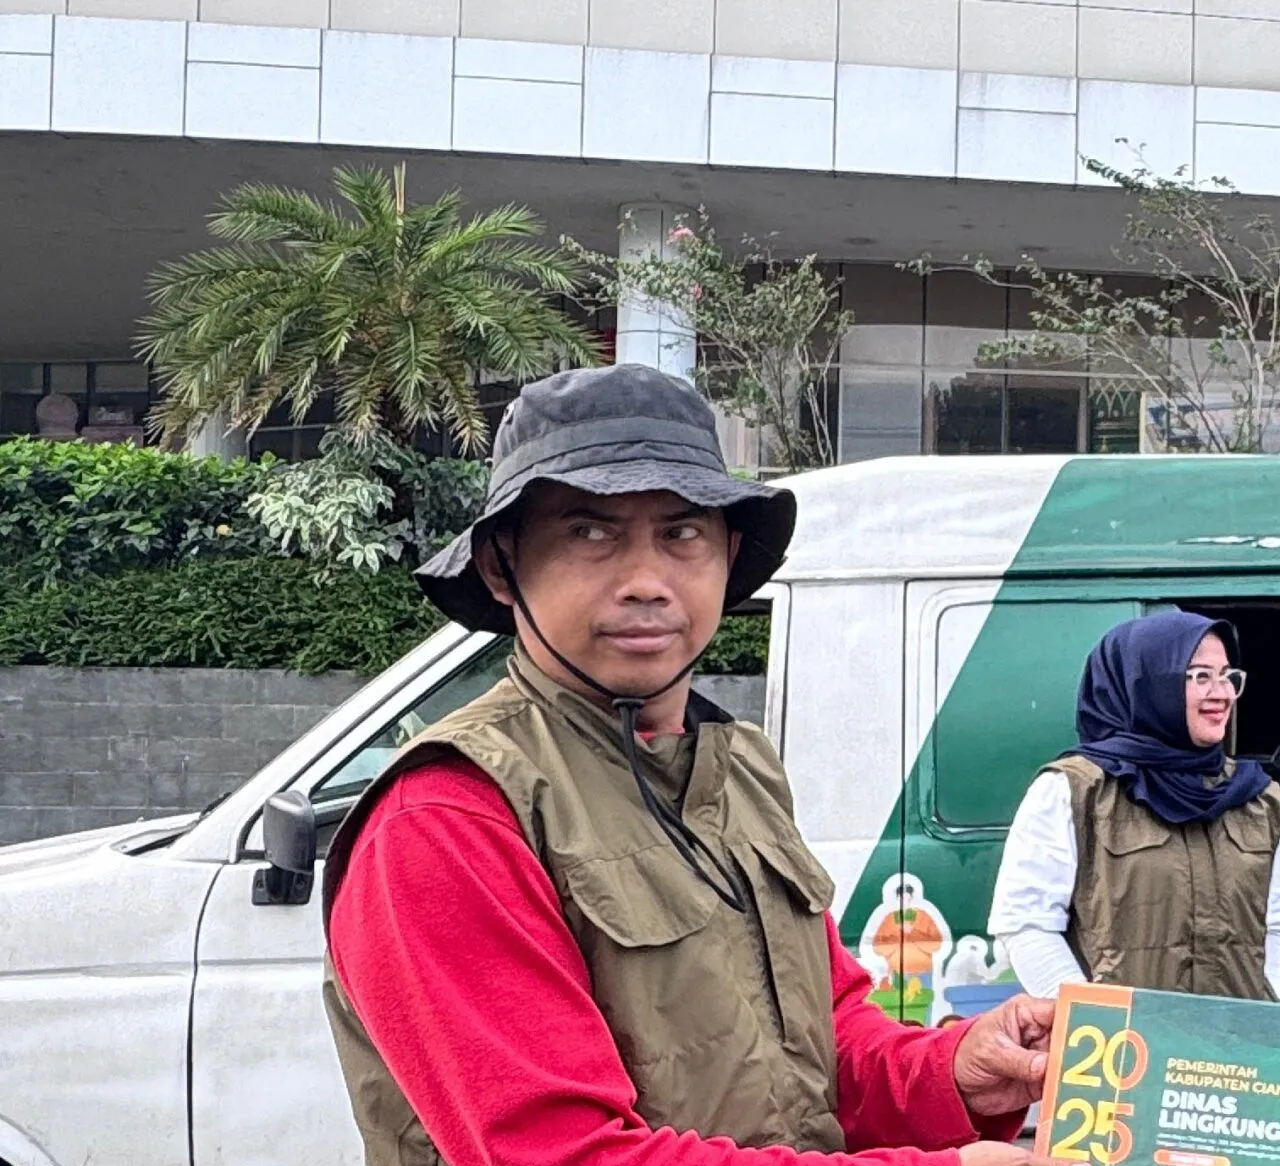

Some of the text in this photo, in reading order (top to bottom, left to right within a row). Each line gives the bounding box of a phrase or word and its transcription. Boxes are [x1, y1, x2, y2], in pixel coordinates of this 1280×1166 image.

[1062, 1025, 1148, 1090] 20
[1166, 1057, 1258, 1079] PEMERINTAH
[1164, 1071, 1250, 1092] KABUPATEN
[1161, 1089, 1238, 1115] DINAS
[1051, 1098, 1135, 1165] 25
